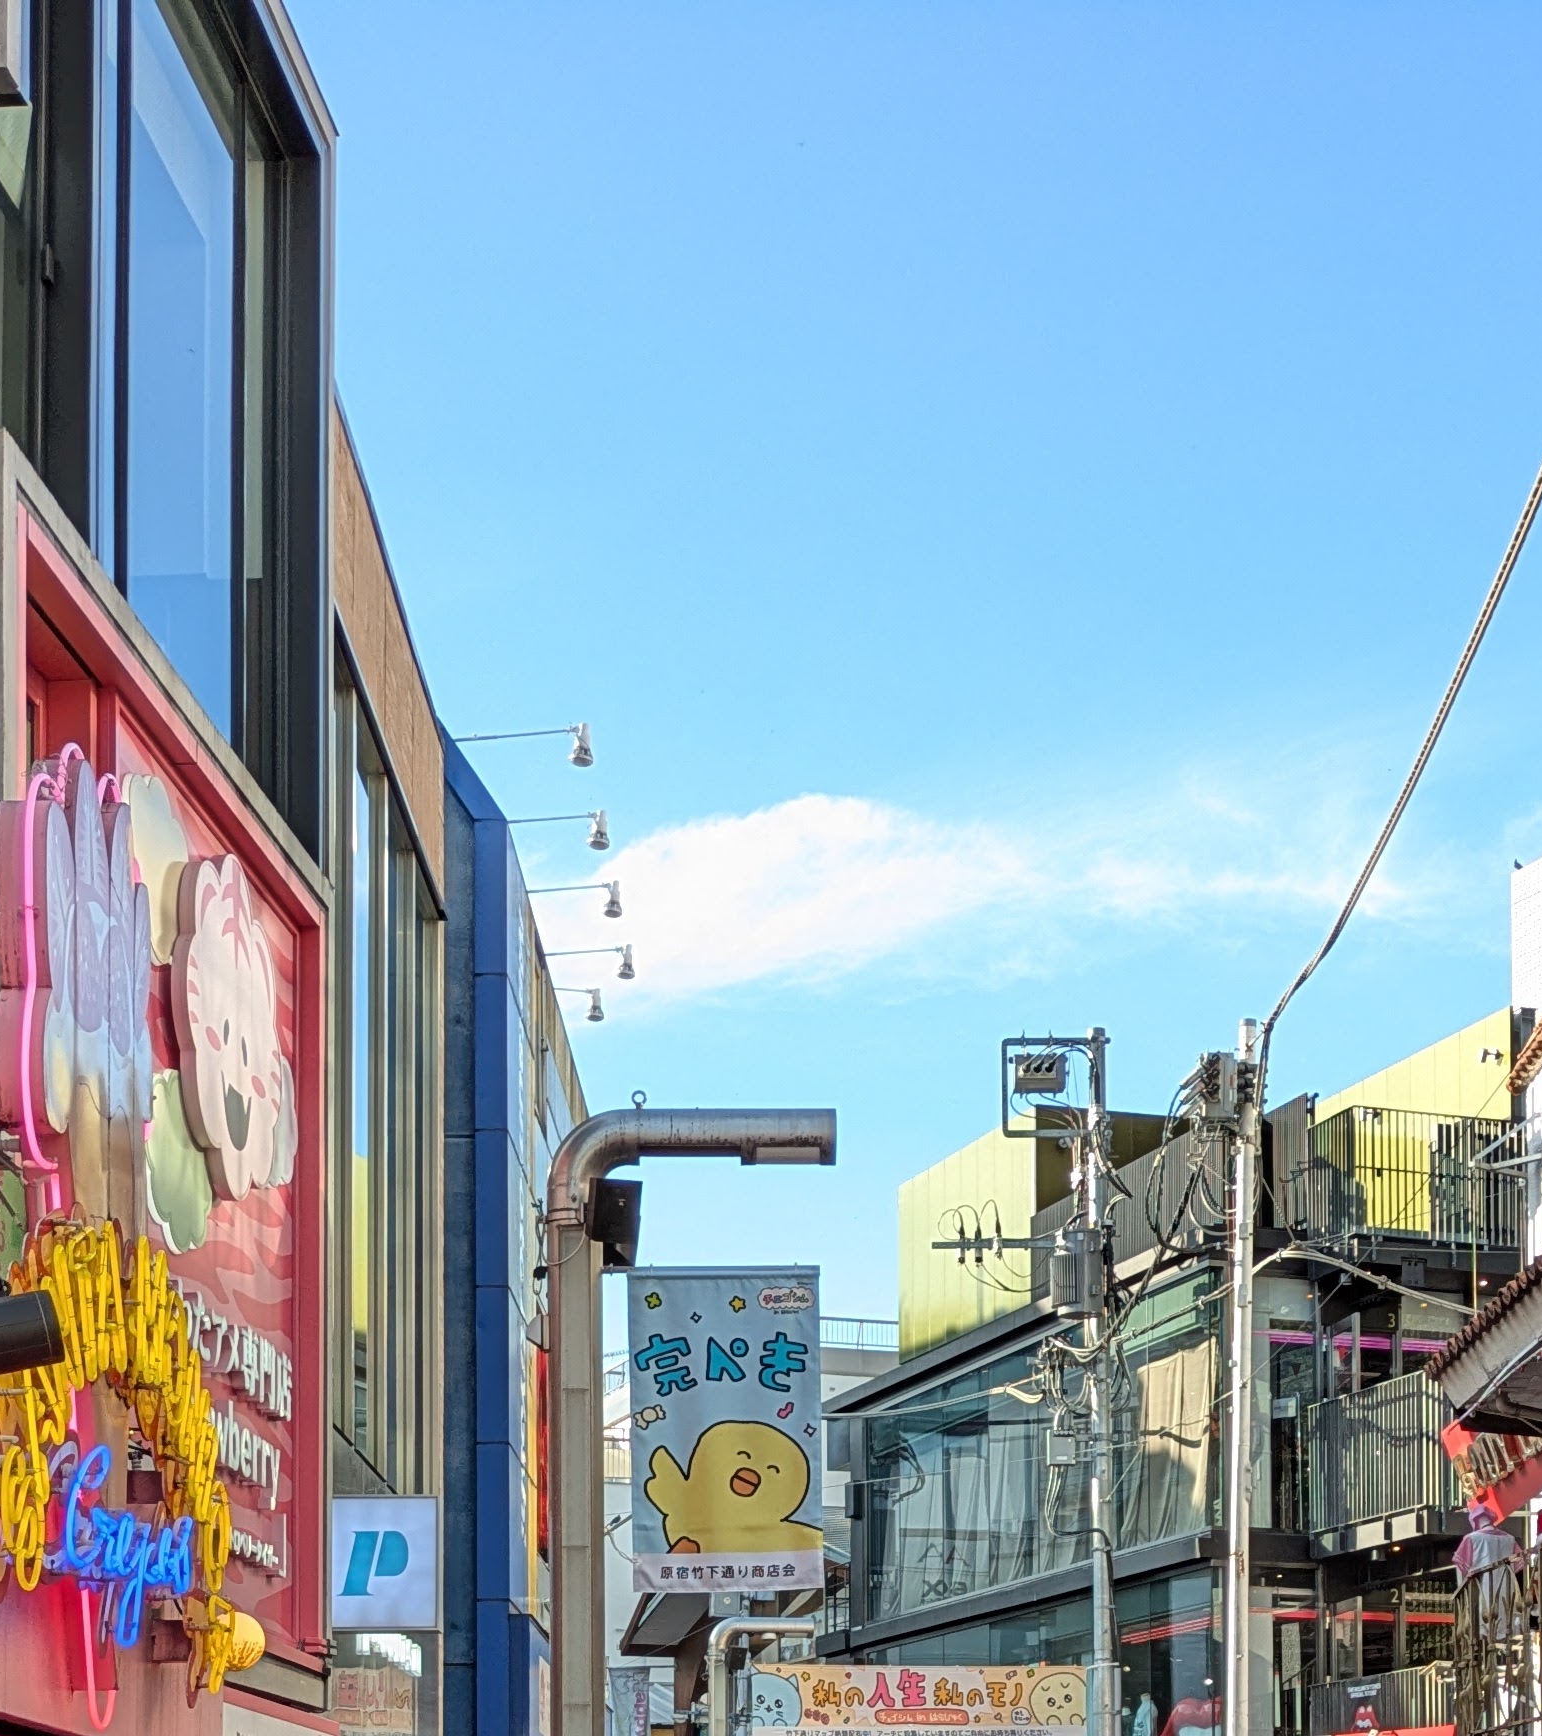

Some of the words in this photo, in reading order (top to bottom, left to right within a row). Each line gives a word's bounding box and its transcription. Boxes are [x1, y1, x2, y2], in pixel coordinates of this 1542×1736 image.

[1387, 1313, 1396, 1329] 3
[634, 1331, 809, 1397] 完ぺき
[660, 1563, 797, 1581] 原宿竹下通り商店会
[1390, 1587, 1399, 1604] 2
[812, 1679, 864, 1708] 私の
[866, 1668, 926, 1708] 人生
[933, 1677, 1023, 1708] 私のモノ
